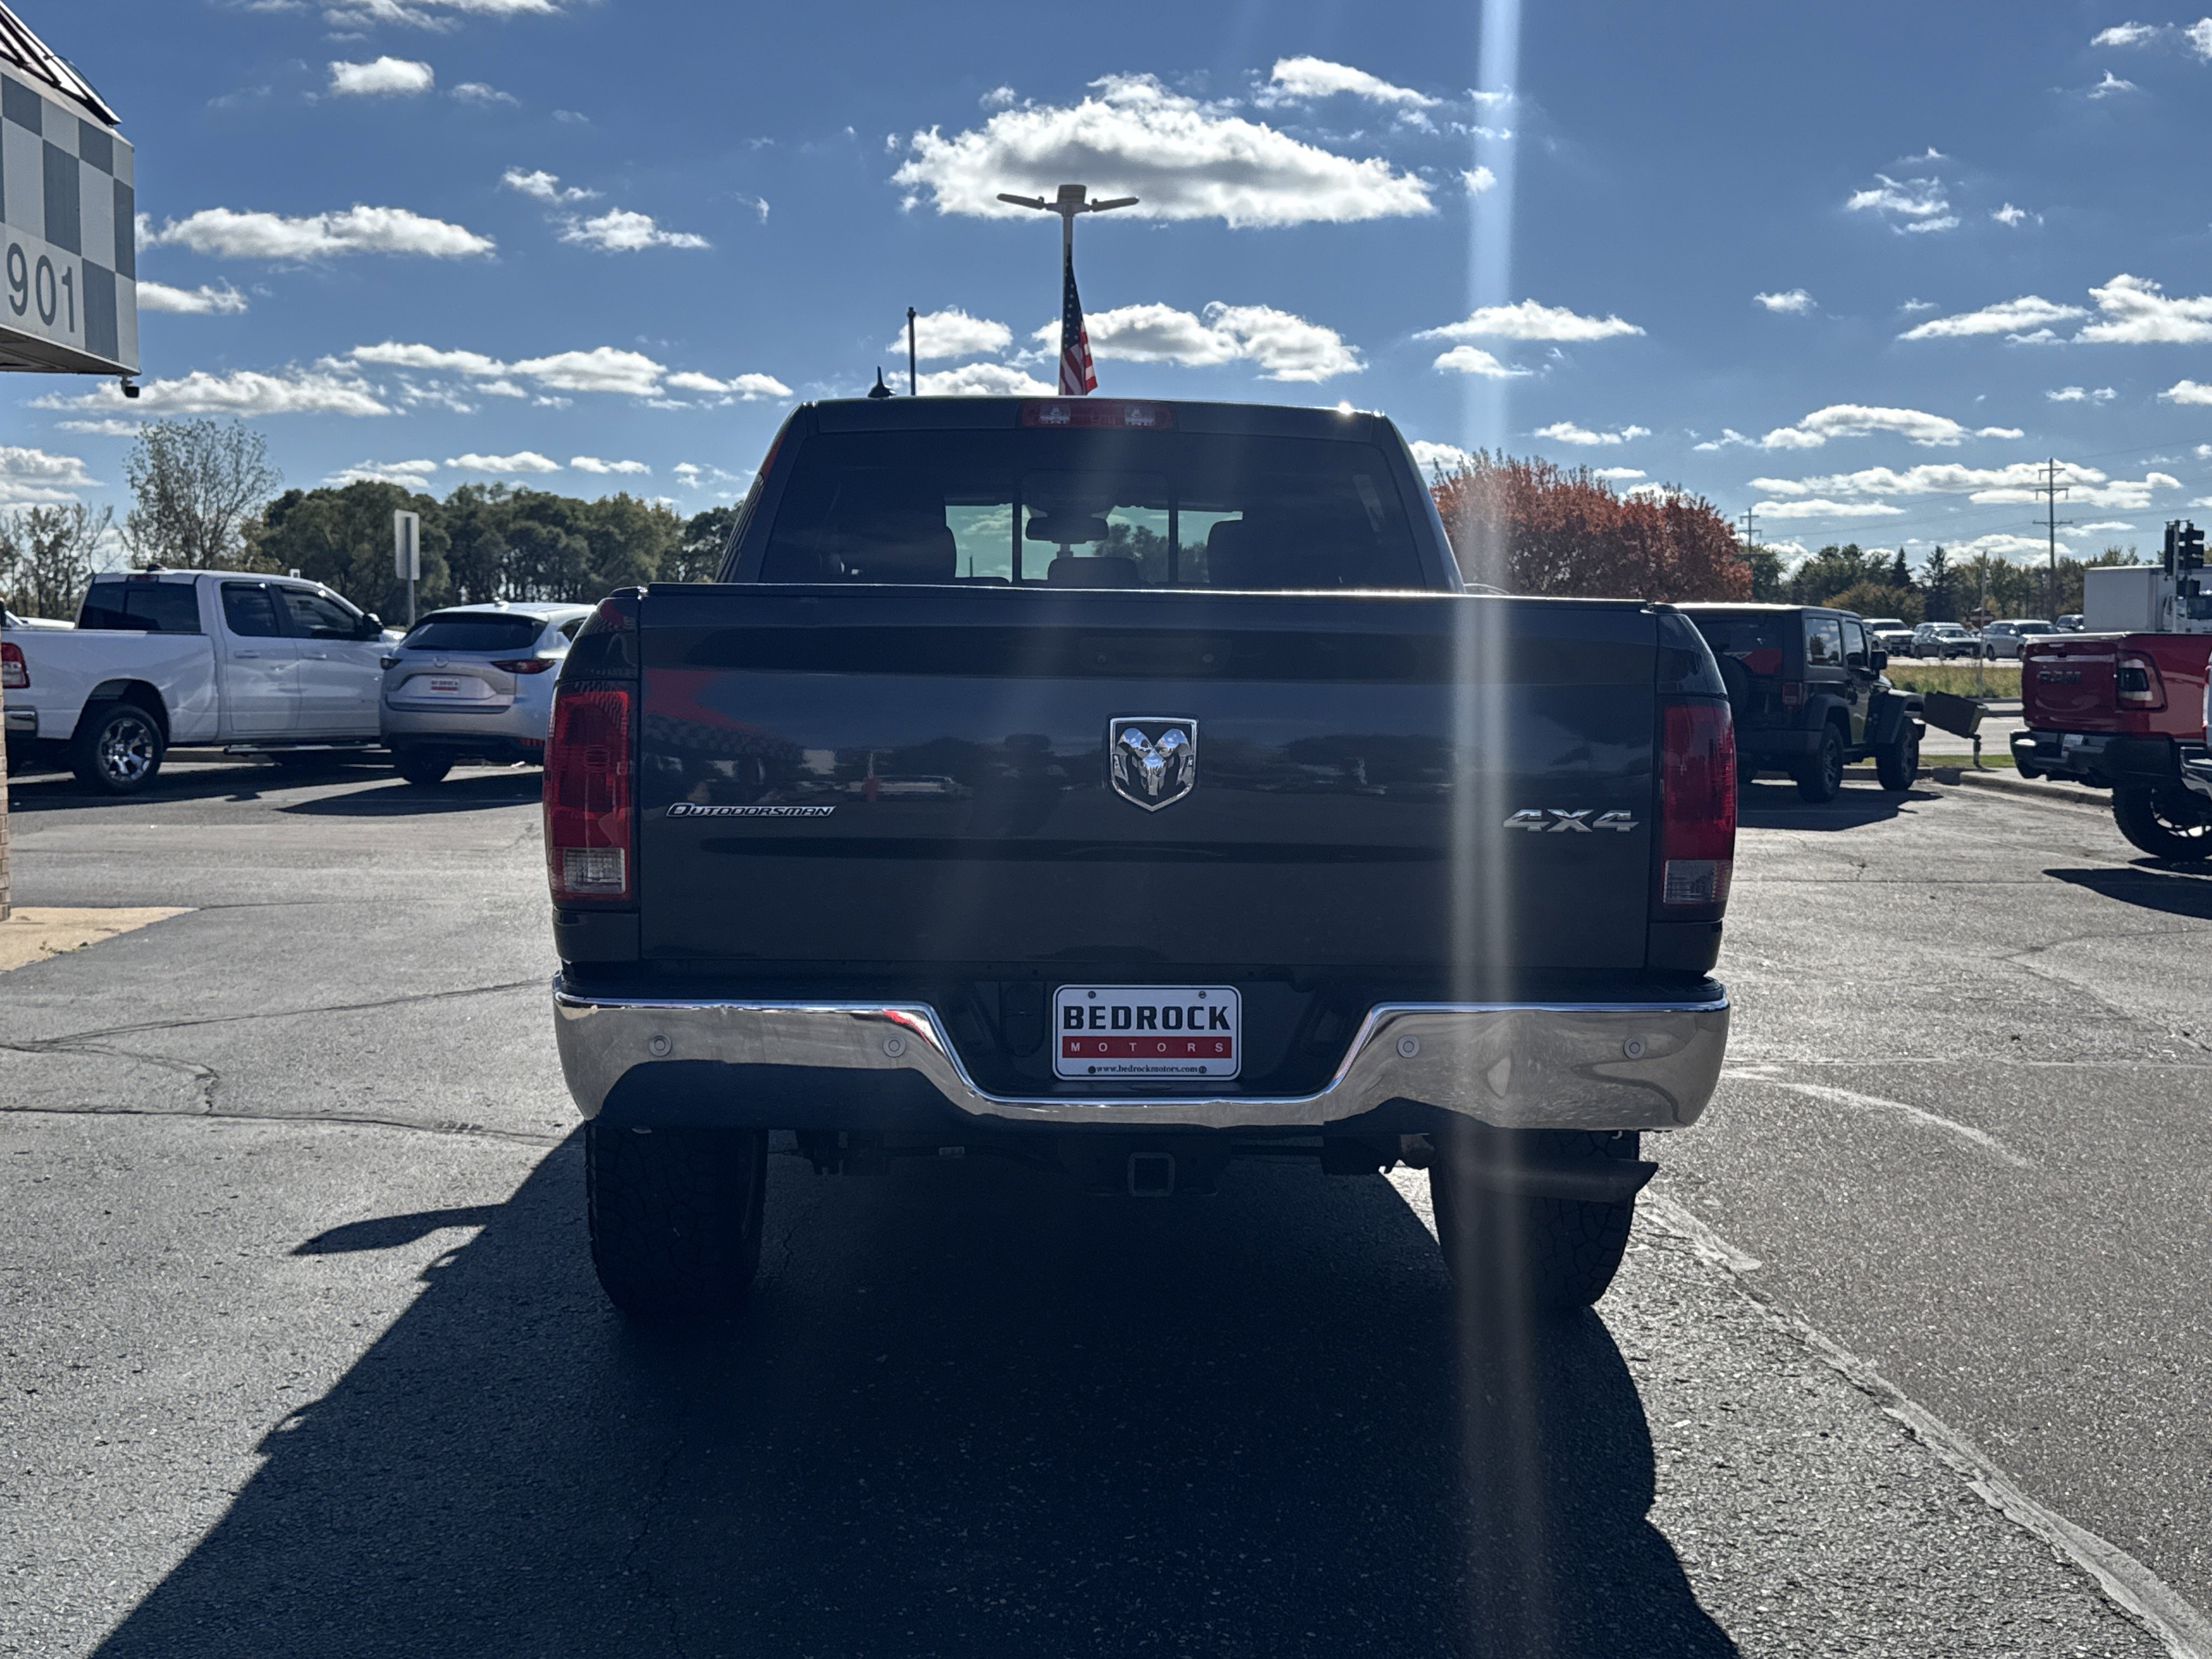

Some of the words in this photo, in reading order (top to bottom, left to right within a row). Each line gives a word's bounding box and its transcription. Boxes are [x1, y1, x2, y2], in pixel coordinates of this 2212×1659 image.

[7, 242, 75, 333] 901
[667, 803, 836, 816] OUTDOORSMAN
[1063, 1006, 1231, 1030] BEDROCK
[1070, 1042, 1224, 1052] MOTORS
